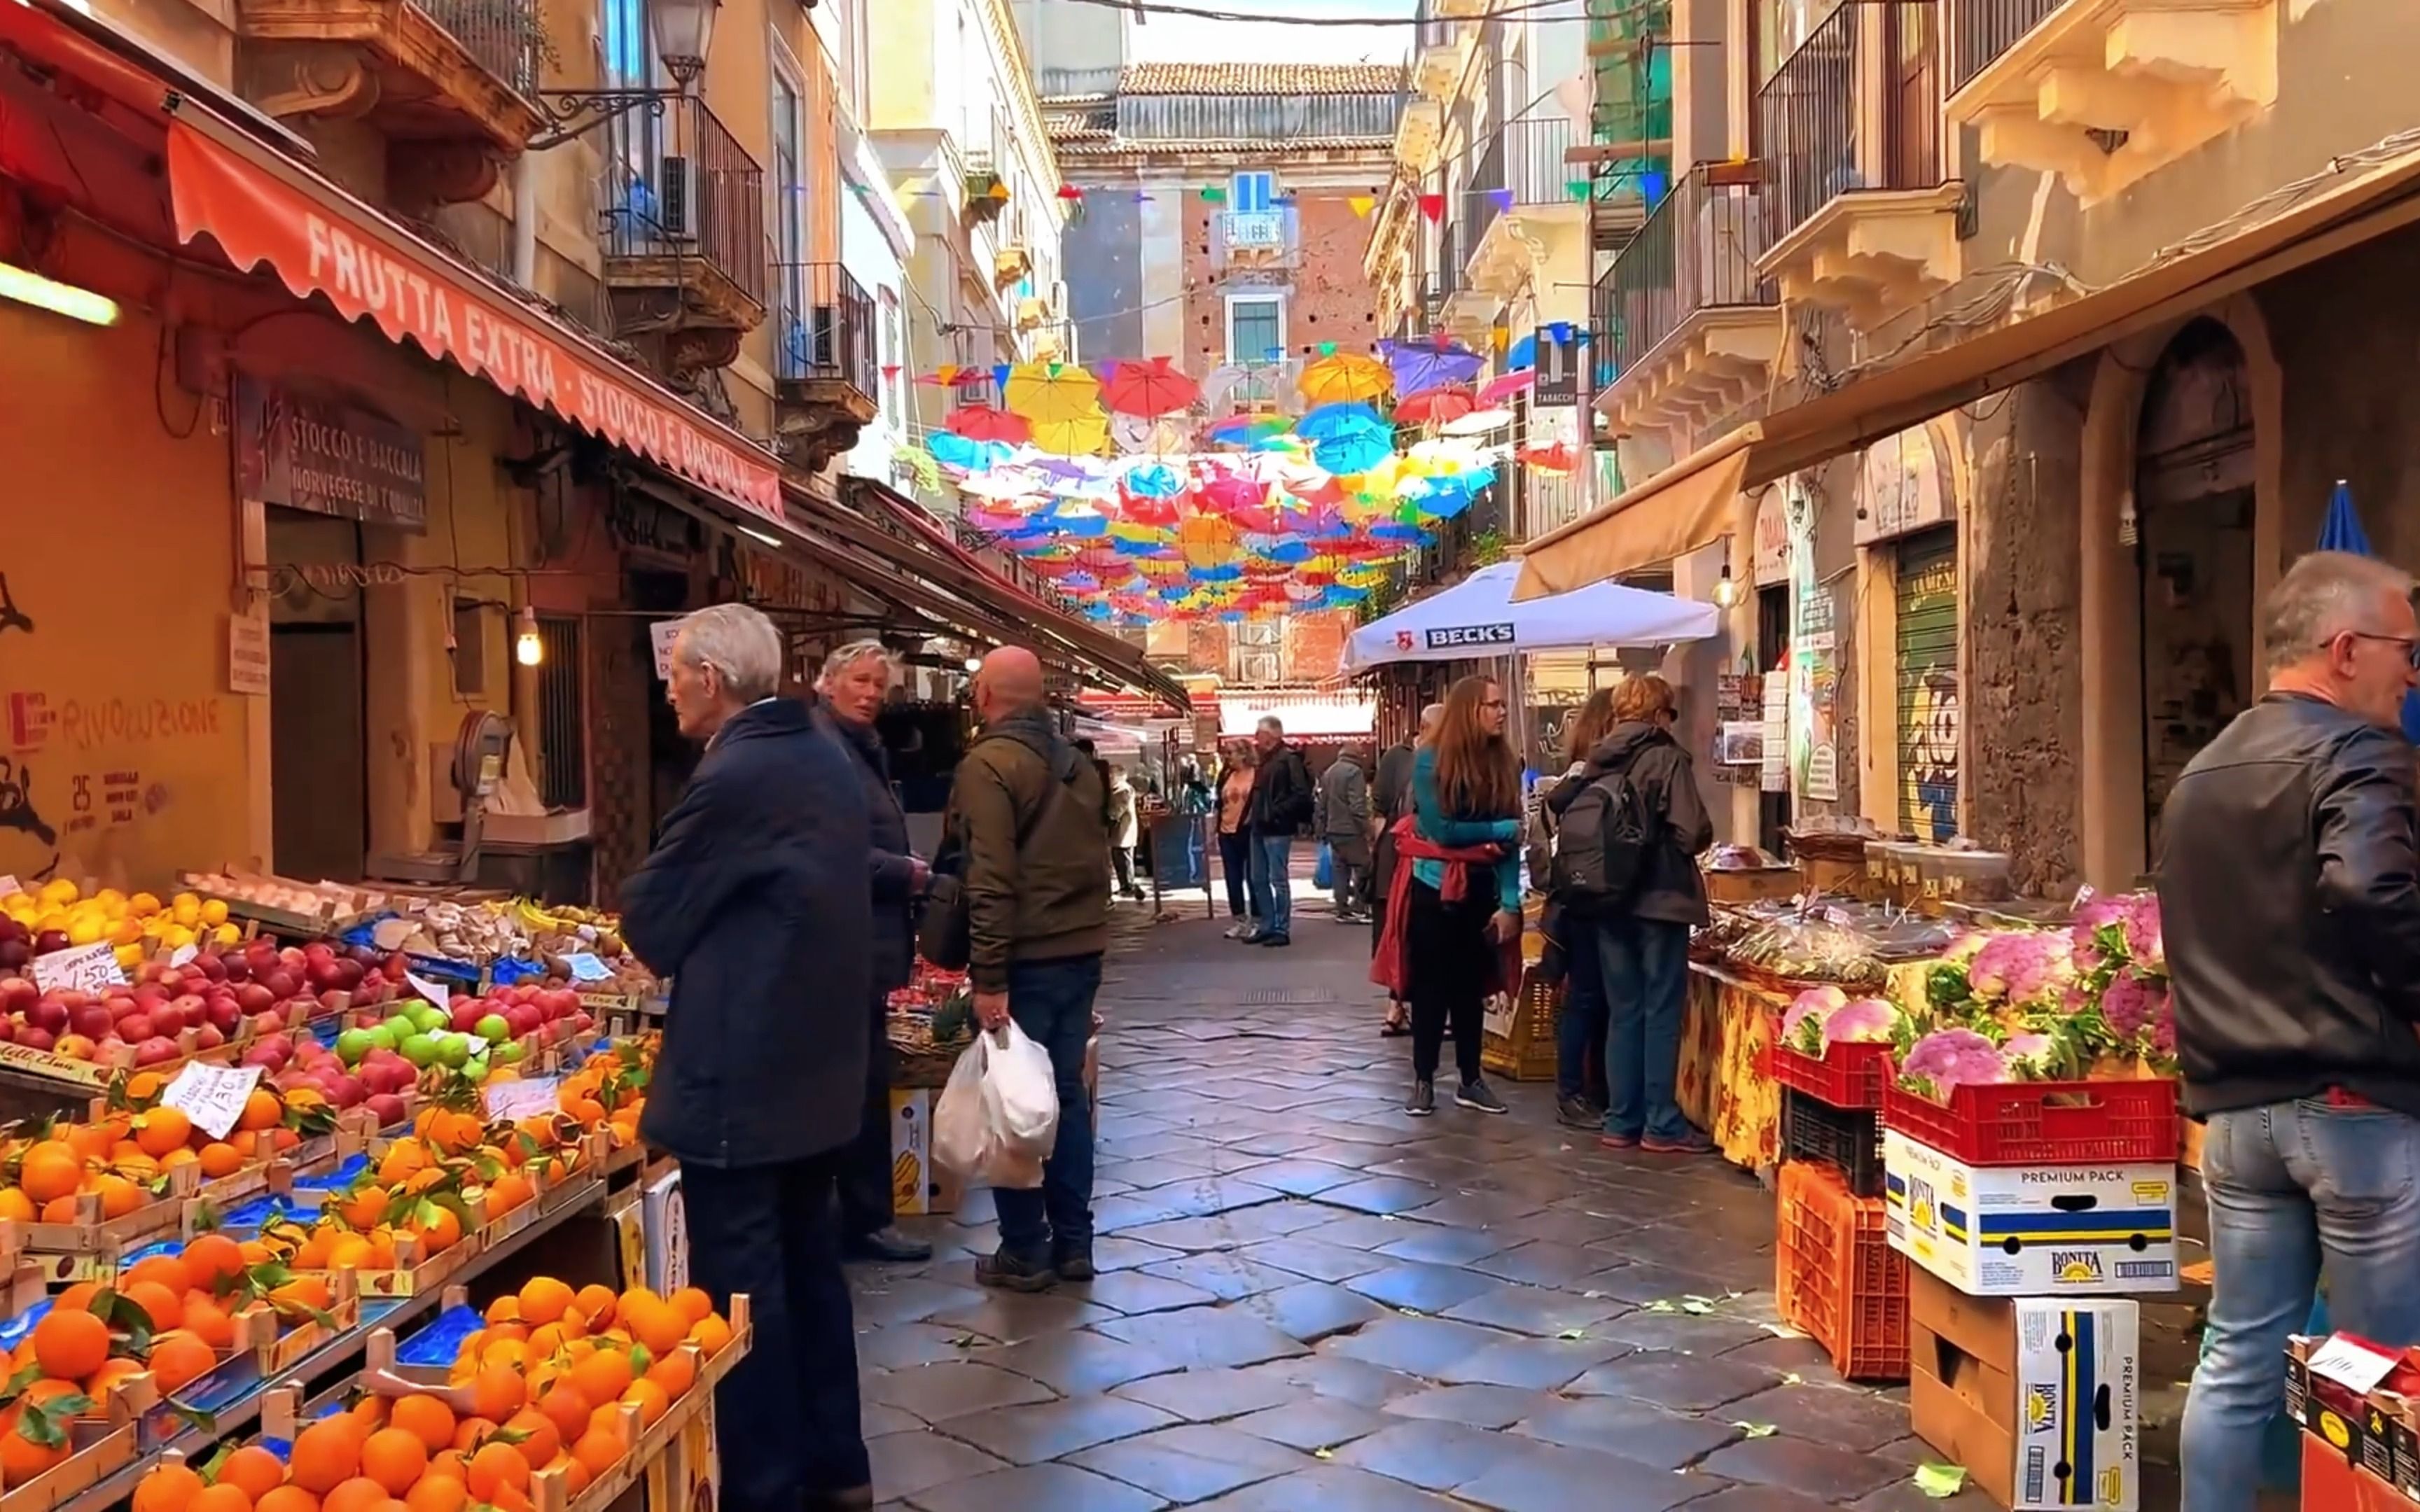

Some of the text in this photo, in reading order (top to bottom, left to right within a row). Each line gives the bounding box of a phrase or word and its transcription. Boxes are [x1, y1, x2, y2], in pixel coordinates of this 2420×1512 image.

[307, 212, 454, 351] FRUTTA
[465, 303, 557, 400] EXTRA
[579, 371, 660, 450] STOCCO
[666, 422, 676, 458] E
[291, 416, 351, 460] STOCCO
[356, 436, 364, 463] E
[292, 466, 364, 503] NORVEGESE
[1430, 624, 1513, 645] BECK'S
[62, 697, 219, 750] RIVOLUZIONE
[1909, 1173, 1937, 1226] BONITA
[2021, 1170, 2125, 1183] PREMIUM PACK
[2051, 1251, 2103, 1275] BONITA
[2033, 1382, 2057, 1434] BONITA
[2122, 1356, 2133, 1460] PREMIUM PACK
